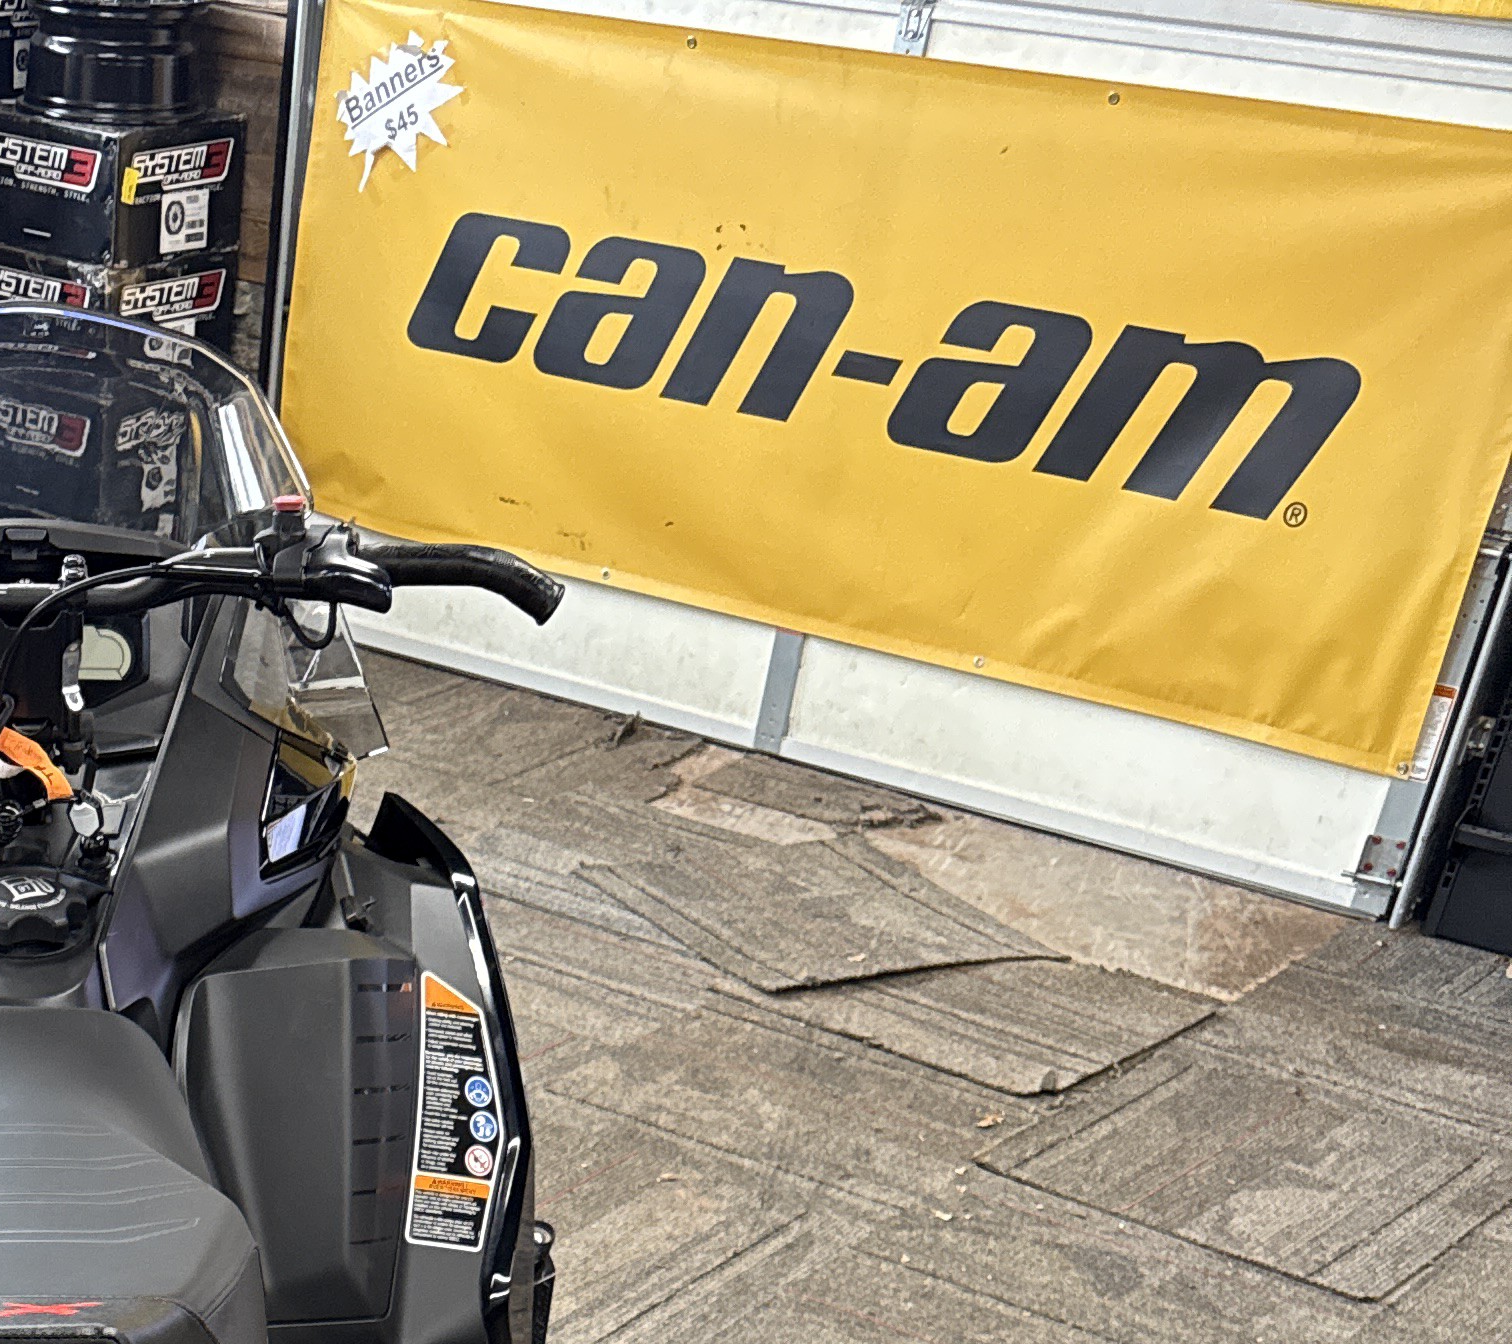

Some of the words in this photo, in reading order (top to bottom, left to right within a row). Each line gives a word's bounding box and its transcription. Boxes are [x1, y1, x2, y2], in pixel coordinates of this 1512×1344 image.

[345, 48, 440, 124] Banners
[384, 103, 419, 140] $45
[132, 145, 208, 179] SYSTEM
[121, 276, 200, 311] SYSTEM
